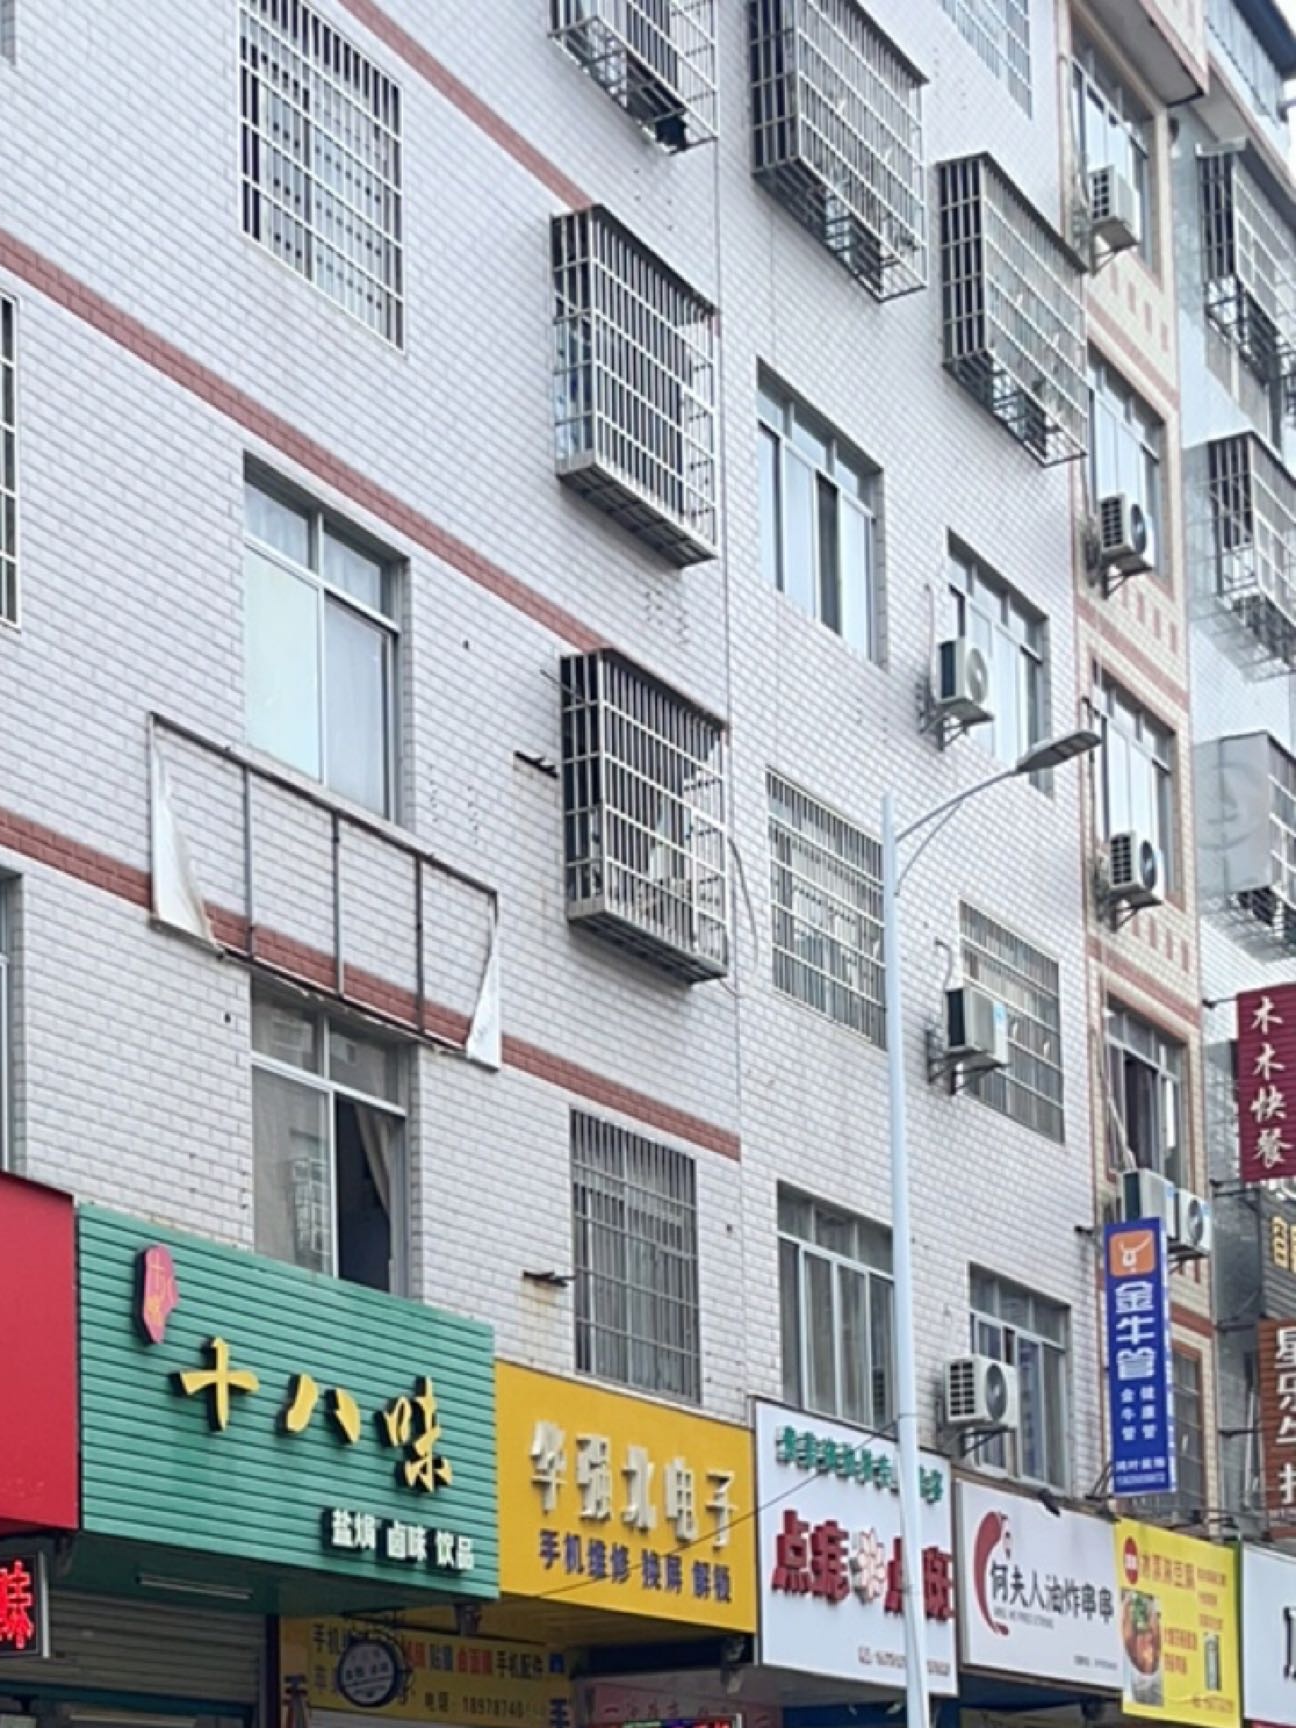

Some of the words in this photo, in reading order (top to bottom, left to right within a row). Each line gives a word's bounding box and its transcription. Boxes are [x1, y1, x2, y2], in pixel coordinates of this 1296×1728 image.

[1251, 996, 1294, 1169] 木木快餐
[178, 1336, 453, 1492] 十八味
[530, 1420, 737, 1551] 华强北电子
[437, 1531, 474, 1571] 饮品
[539, 1528, 630, 1586] 手机维修
[991, 1560, 1115, 1625] 何夫人油炸串串
